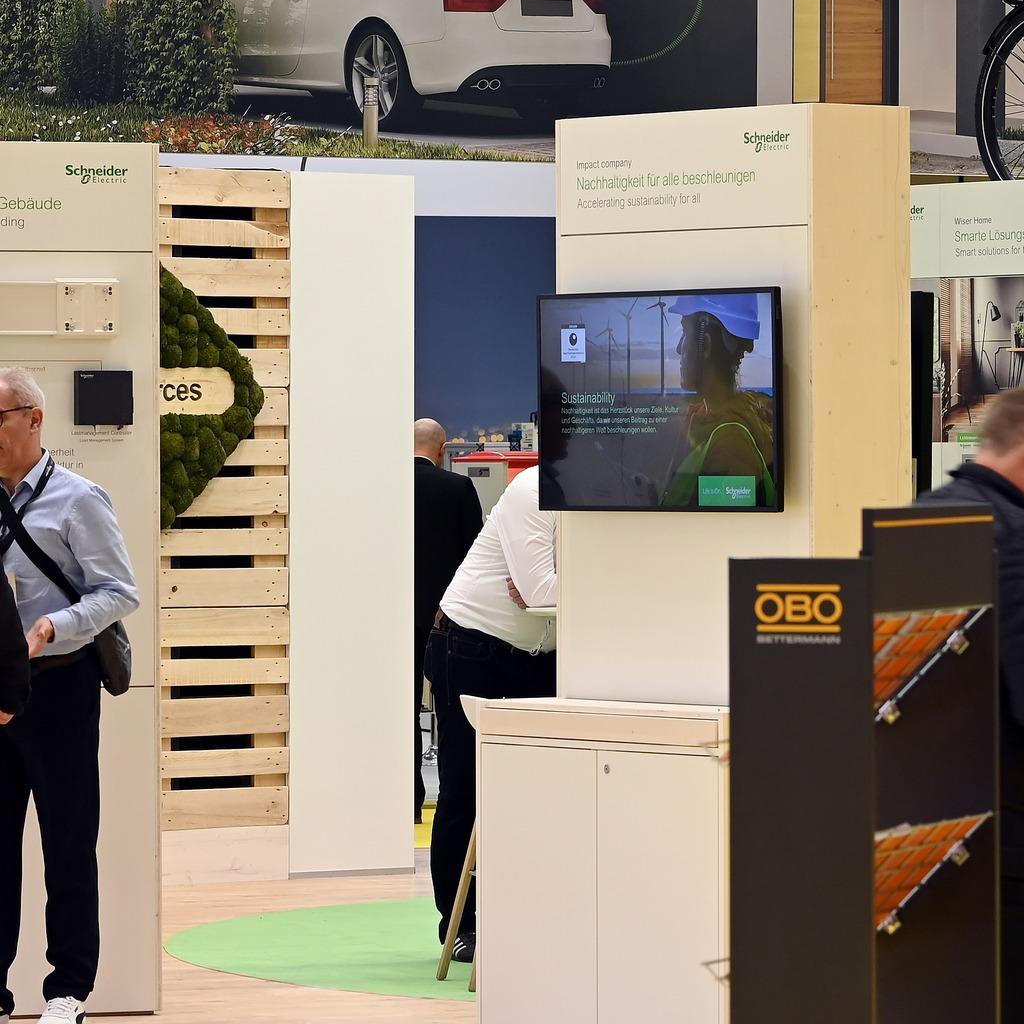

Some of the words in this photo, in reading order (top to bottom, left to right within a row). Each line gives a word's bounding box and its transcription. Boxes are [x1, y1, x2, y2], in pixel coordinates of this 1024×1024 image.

[743, 130, 790, 144] Schneider
[65, 164, 128, 176] Schneider
[576, 160, 599, 170] Impact
[601, 159, 632, 169] company
[576, 174, 644, 192] Nachhaltigkeit
[647, 173, 660, 187] für
[662, 172, 680, 186] alle
[682, 169, 756, 187] beschleunigen
[0, 196, 62, 210] Gebäude
[577, 197, 625, 210] Accelerating
[627, 194, 677, 208] sustainability
[679, 193, 690, 204] for
[692, 193, 701, 204] all
[910, 205, 925, 215] der
[0, 216, 25, 230] ding
[954, 217, 972, 225] Wiser
[973, 216, 993, 225] Home
[954, 230, 987, 243] Smarte
[955, 247, 977, 257] Smart
[978, 245, 1010, 256] solutions
[1011, 245, 1021, 255] for
[561, 391, 616, 406] Sustainability
[48, 448, 74, 456] erheit
[56, 461, 74, 469] ktur
[76, 461, 84, 469] in
[754, 592, 843, 624] OBO
